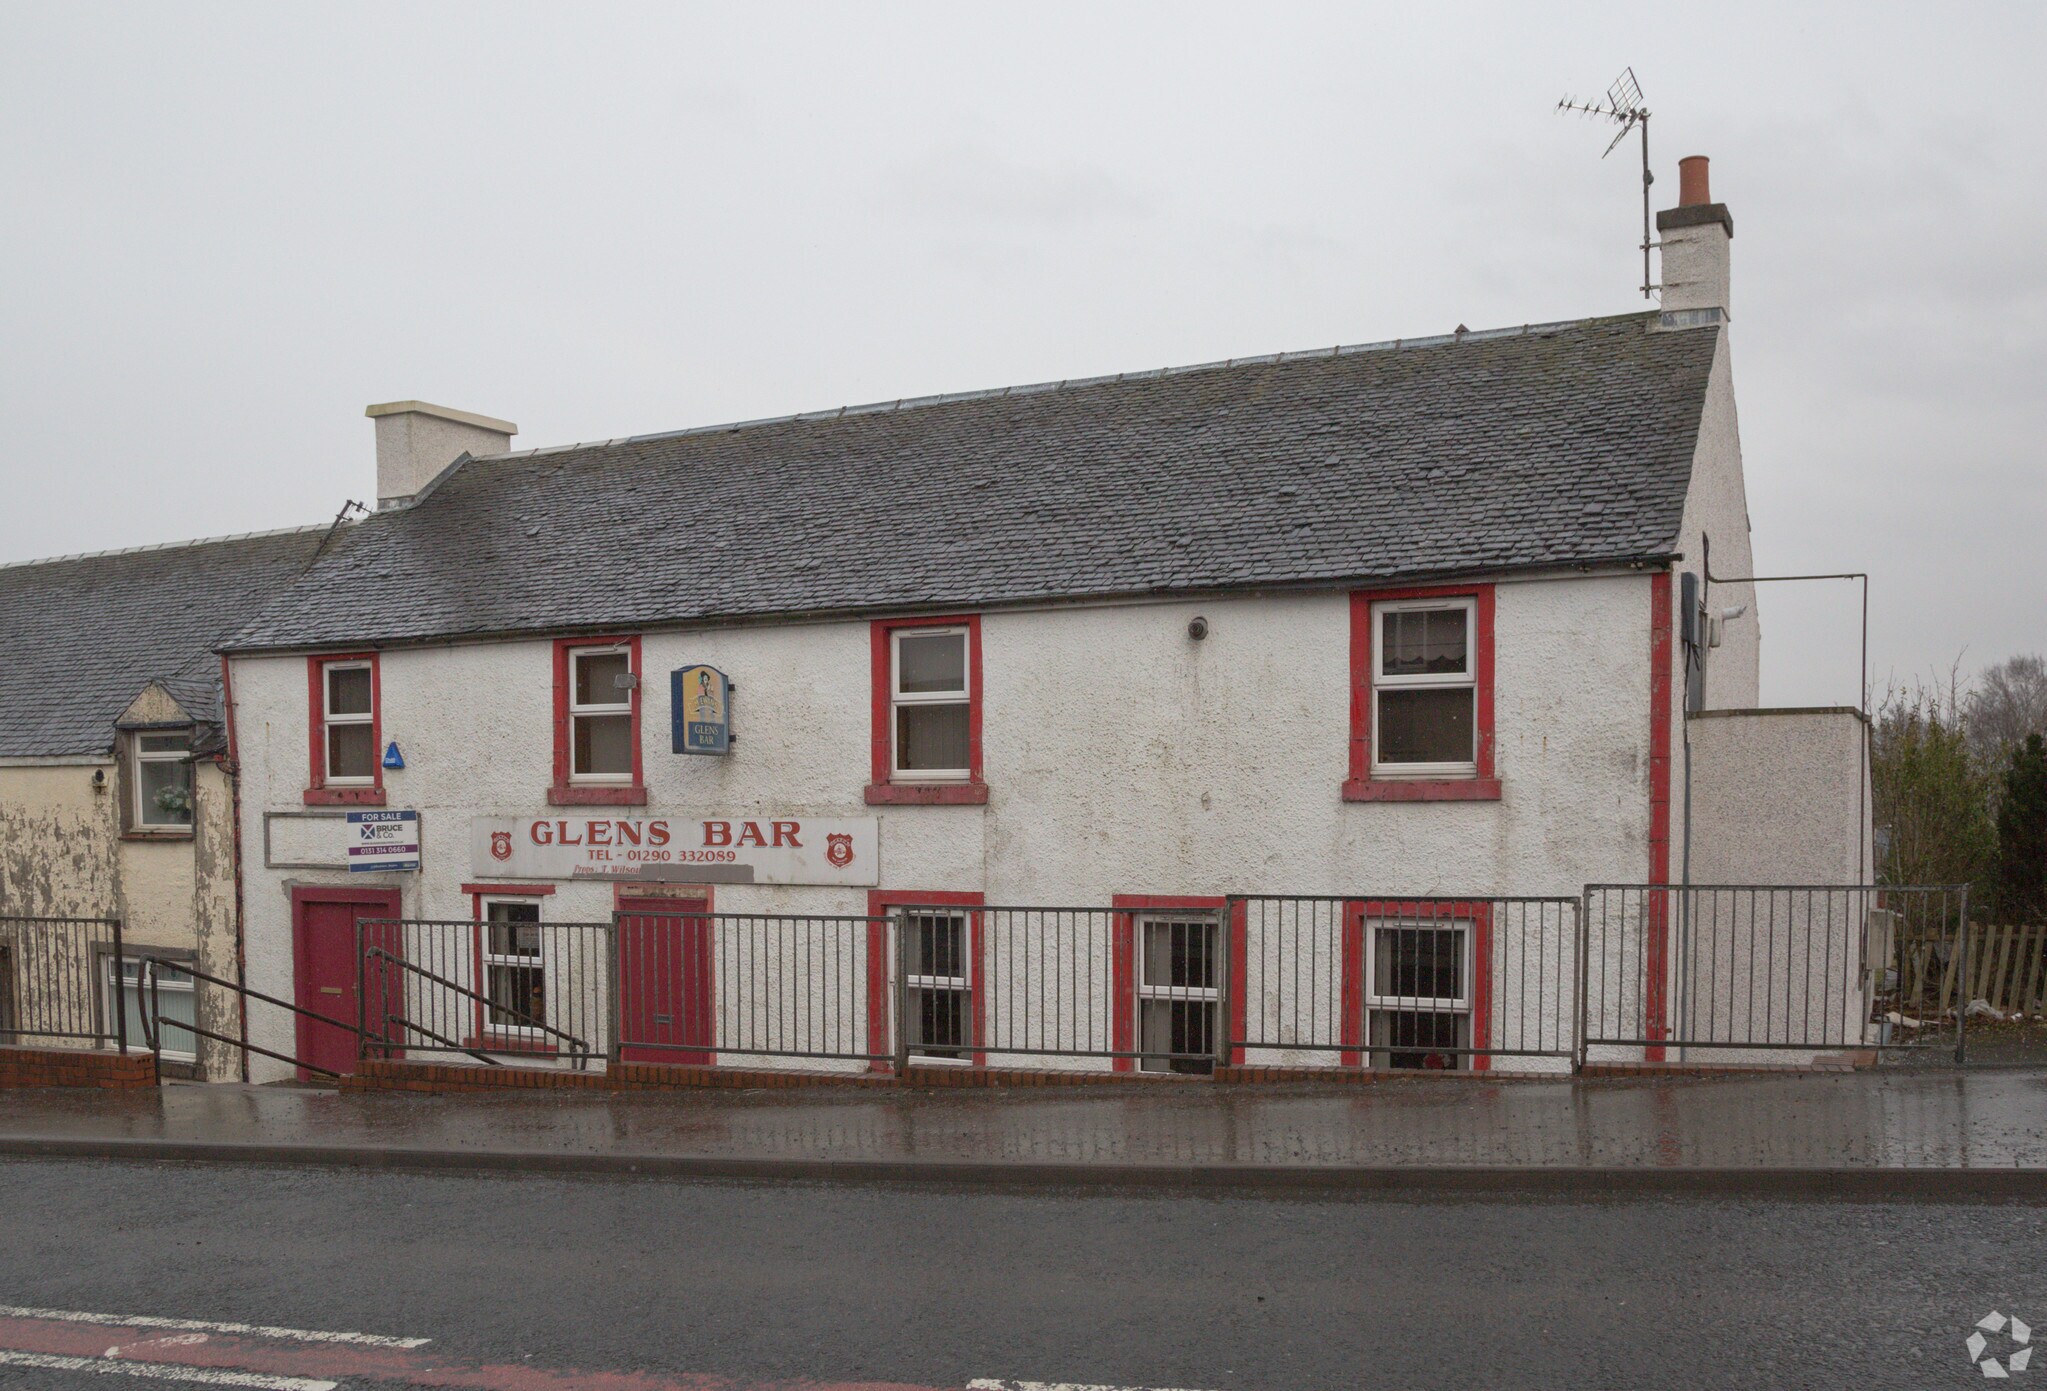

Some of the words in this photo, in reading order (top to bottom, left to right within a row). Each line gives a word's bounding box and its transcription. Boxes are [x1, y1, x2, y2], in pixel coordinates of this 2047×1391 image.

[694, 724, 719, 735] GLENS
[699, 735, 714, 744] BAR
[361, 813, 379, 821] FOR
[380, 812, 401, 820] SALE
[376, 824, 403, 832] BRUCE
[529, 820, 671, 847] GLENS
[701, 820, 804, 848] BAR
[360, 847, 375, 855] 0131
[376, 846, 387, 854] 314
[588, 849, 613, 861] TEL
[627, 849, 671, 861] 01290
[679, 850, 736, 862] 332089
